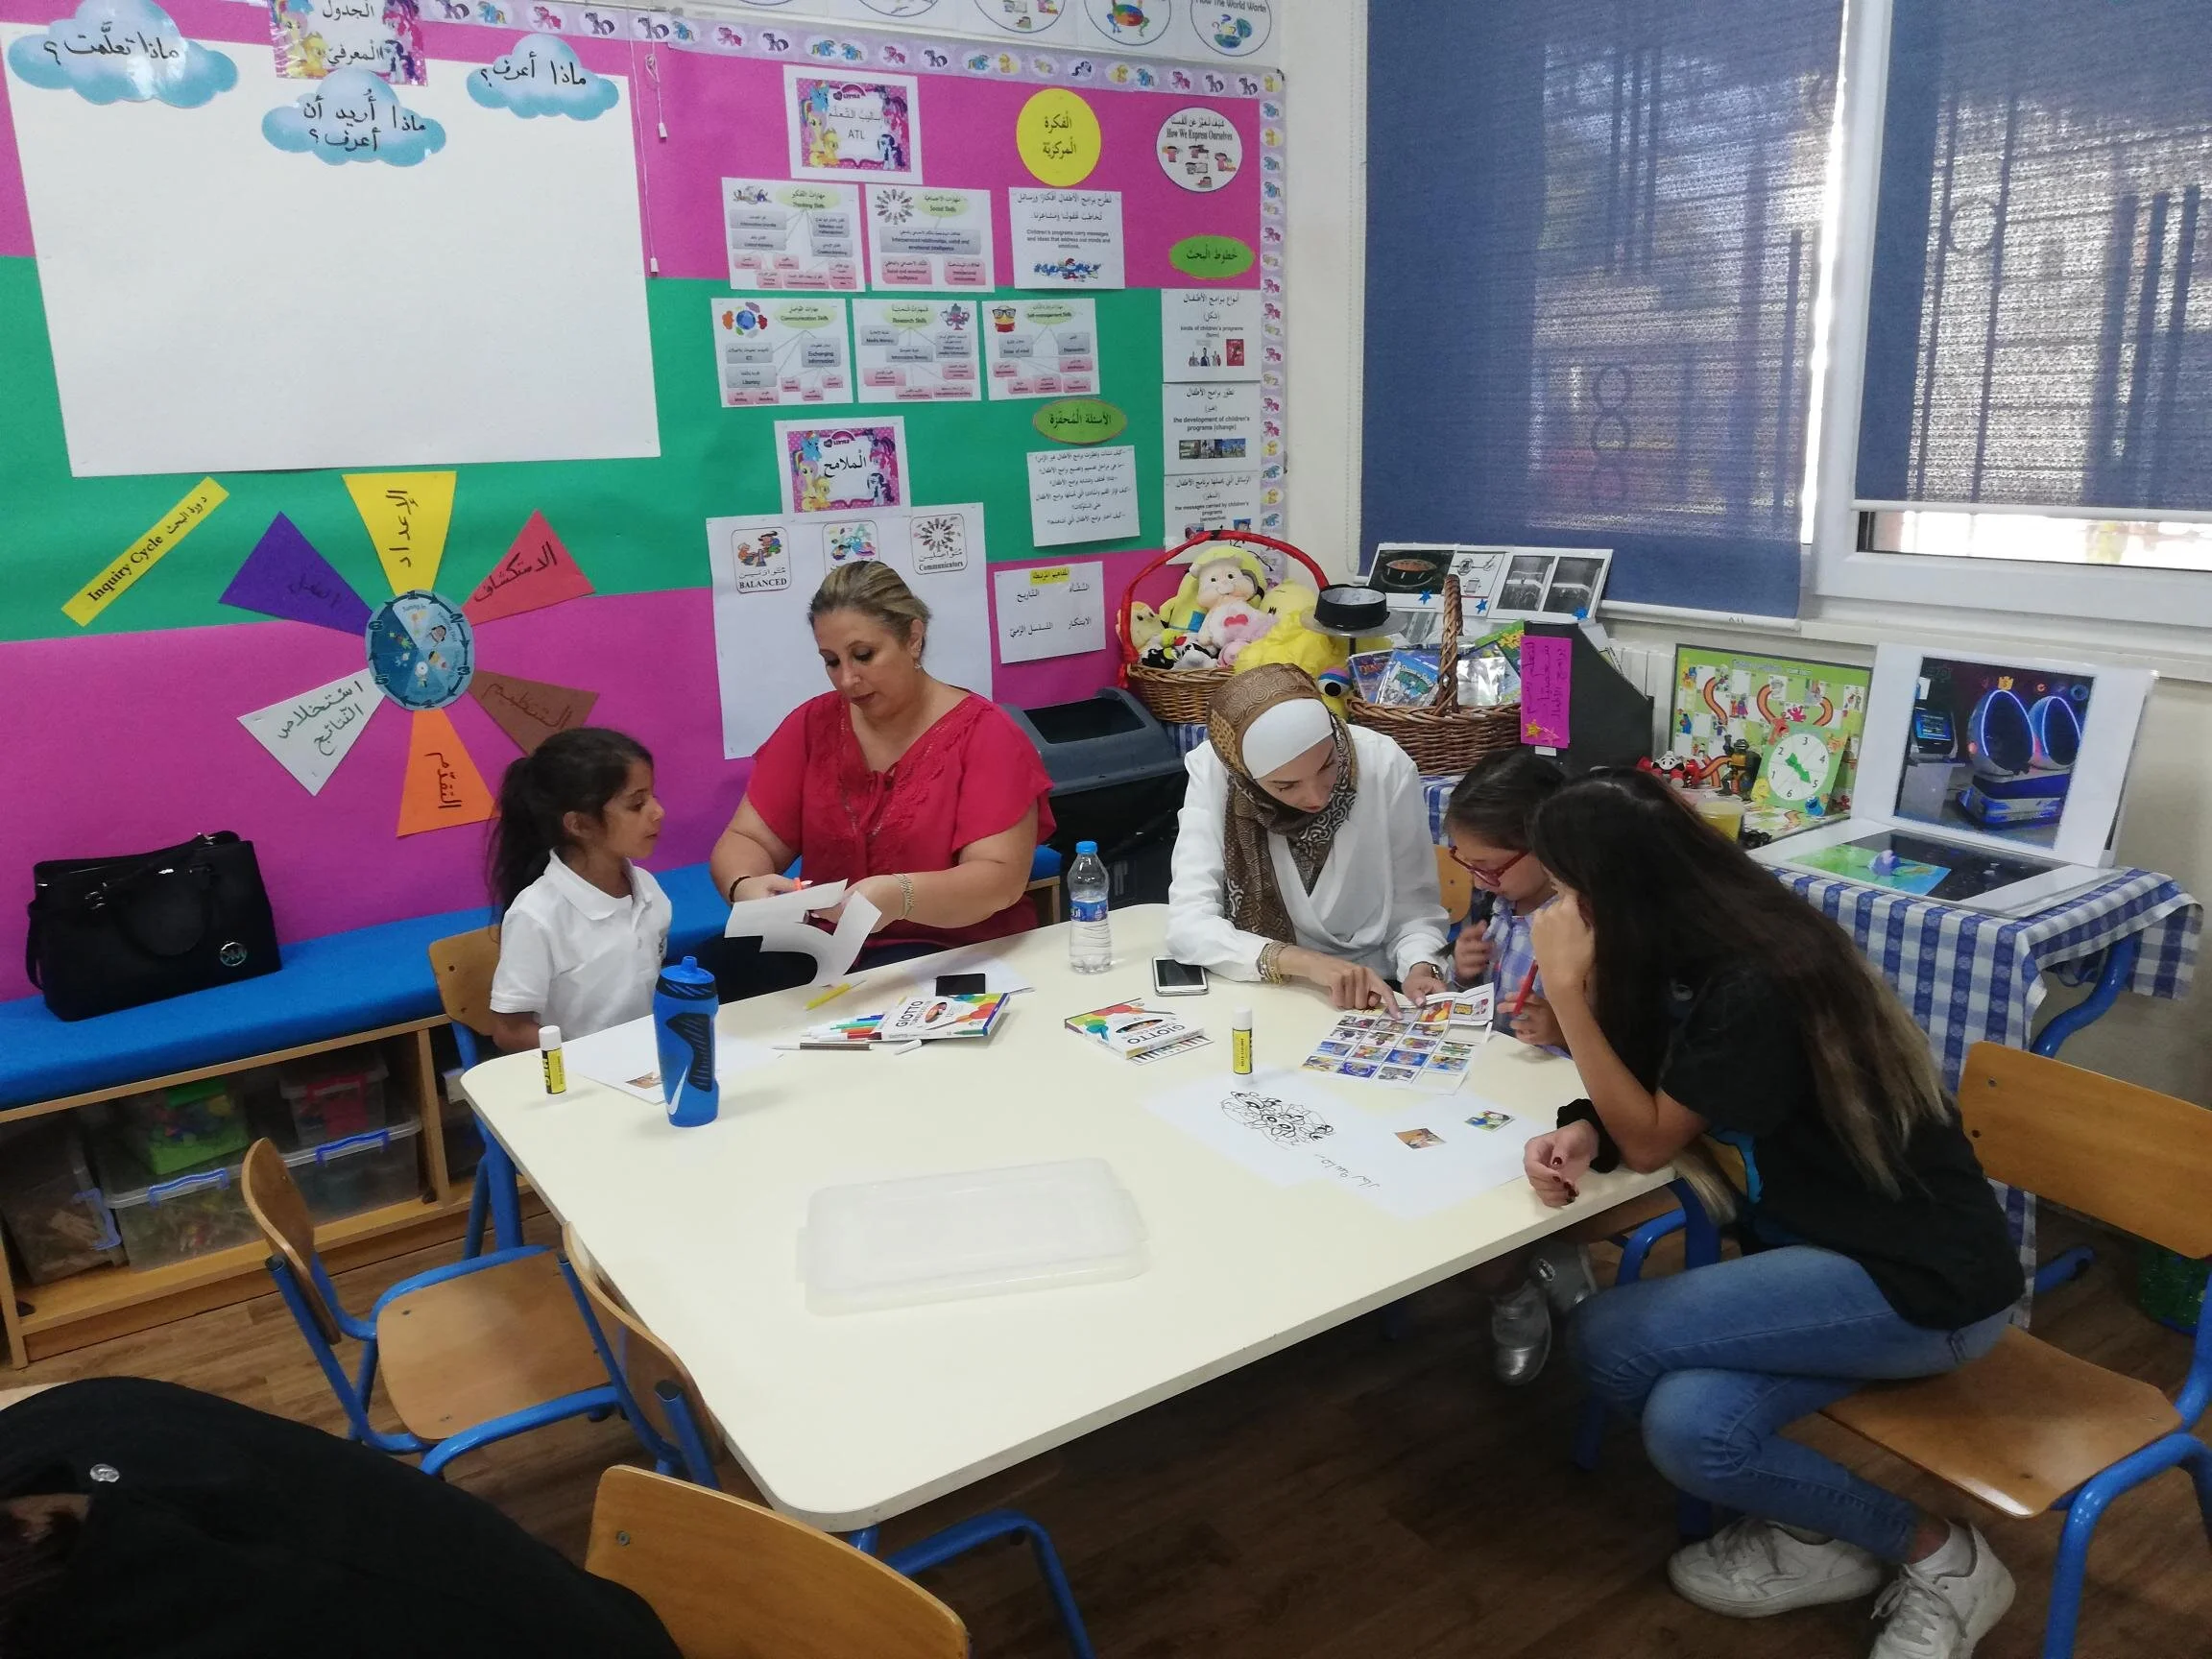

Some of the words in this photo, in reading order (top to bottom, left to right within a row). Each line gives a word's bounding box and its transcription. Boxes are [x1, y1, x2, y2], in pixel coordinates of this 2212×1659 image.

[137, 31, 180, 60] ماذا
[551, 60, 587, 85] ماذا
[303, 95, 324, 120] أن
[392, 105, 427, 132] ماذا
[848, 129, 865, 139] ATL
[1166, 128, 1178, 137] How
[1179, 129, 1188, 138] We
[1189, 129, 1208, 141] Express
[1209, 131, 1233, 140] Ourselves
[86, 564, 133, 602] Inquiry
[130, 536, 163, 565] Cycle
[919, 561, 964, 572] Communicators
[739, 577, 787, 589] BALANCED
[1802, 736, 1809, 745] 3
[1778, 747, 1785, 756] 2
[1818, 755, 1826, 763] 4
[1771, 770, 1776, 779] 1
[1812, 780, 1819, 788] 5
[1787, 789, 1793, 798] 6
[896, 1000, 924, 1027] GIOTTO
[1127, 1023, 1186, 1045] GIOTTO
